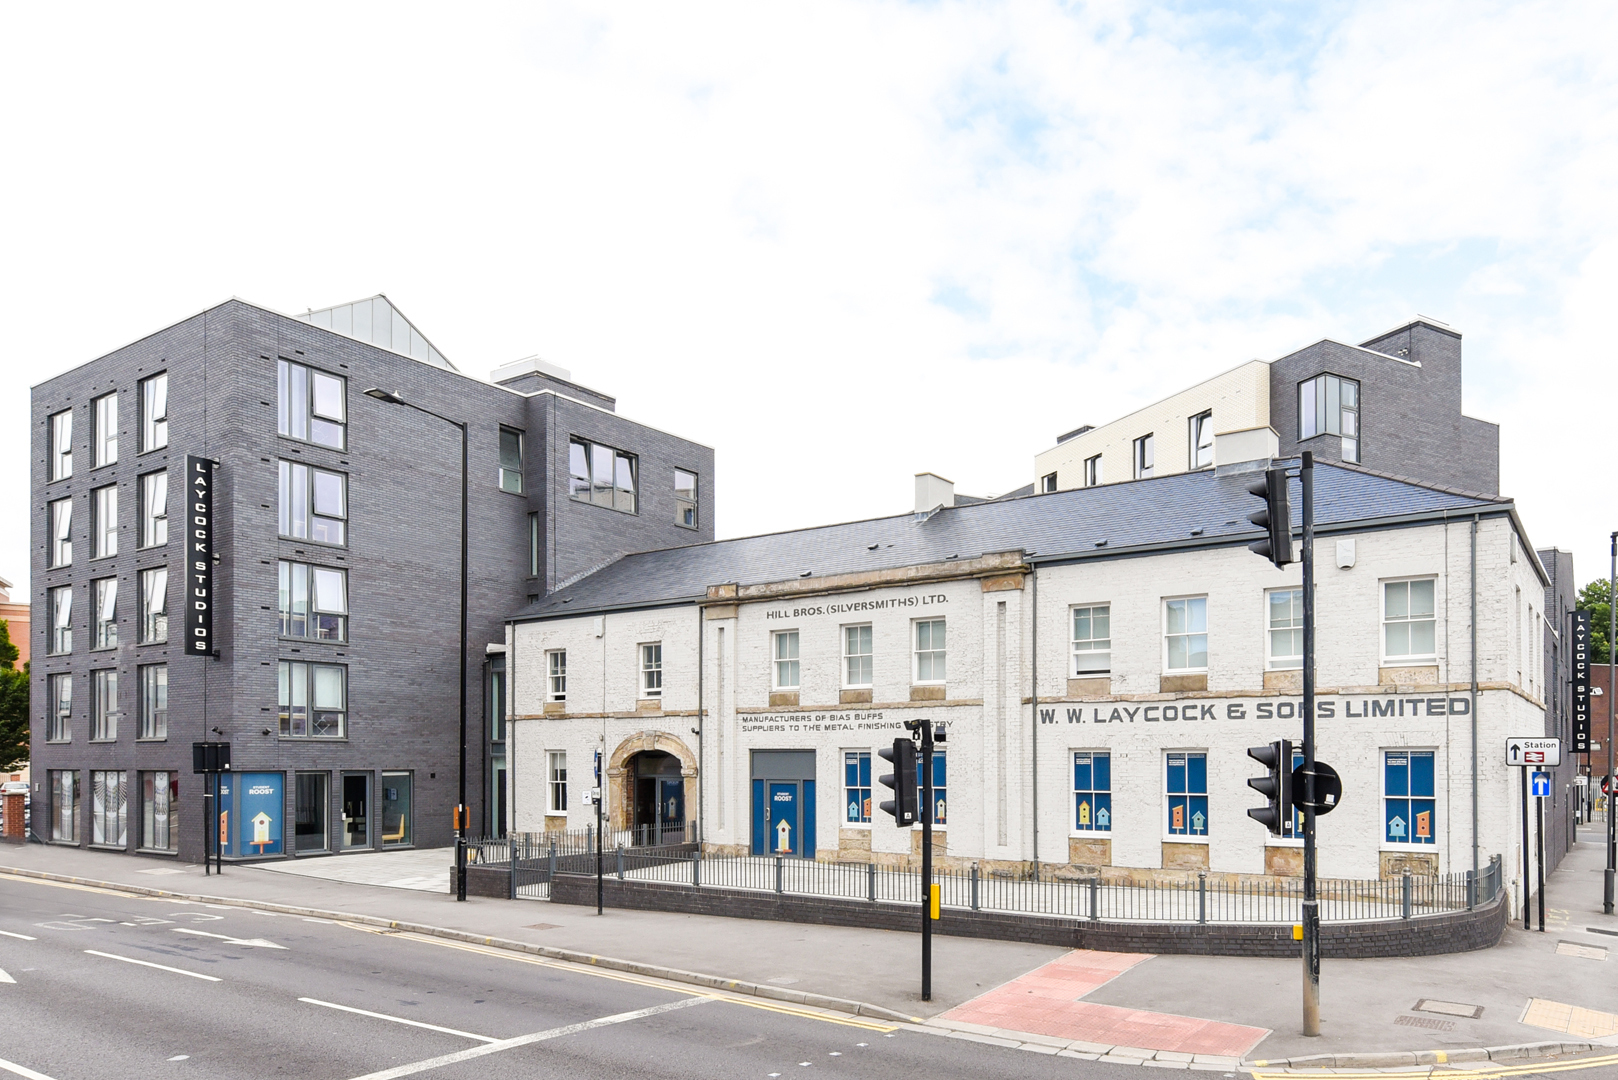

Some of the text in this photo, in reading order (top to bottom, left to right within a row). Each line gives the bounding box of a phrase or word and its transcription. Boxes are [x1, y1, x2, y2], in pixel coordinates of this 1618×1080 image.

[194, 463, 207, 650] LAYCOCK STUDIOS
[766, 610, 790, 619] HILL
[922, 594, 949, 605] LTD.
[1576, 615, 1586, 750] LAYCOCK STUDIOS
[742, 712, 883, 723] MANUFACTURERS OF BIAS BUFFS
[1039, 708, 1059, 724] W.
[1066, 707, 1086, 724] W.
[1094, 704, 1217, 724] LAYCOCK
[1226, 703, 1246, 720] &
[1345, 697, 1470, 718] LIMITED
[742, 724, 786, 732] SUPPLIERS
[789, 724, 800, 732] TO
[824, 723, 854, 731] METAL
[857, 721, 902, 730] FINISHING
[1524, 741, 1557, 749] Station
